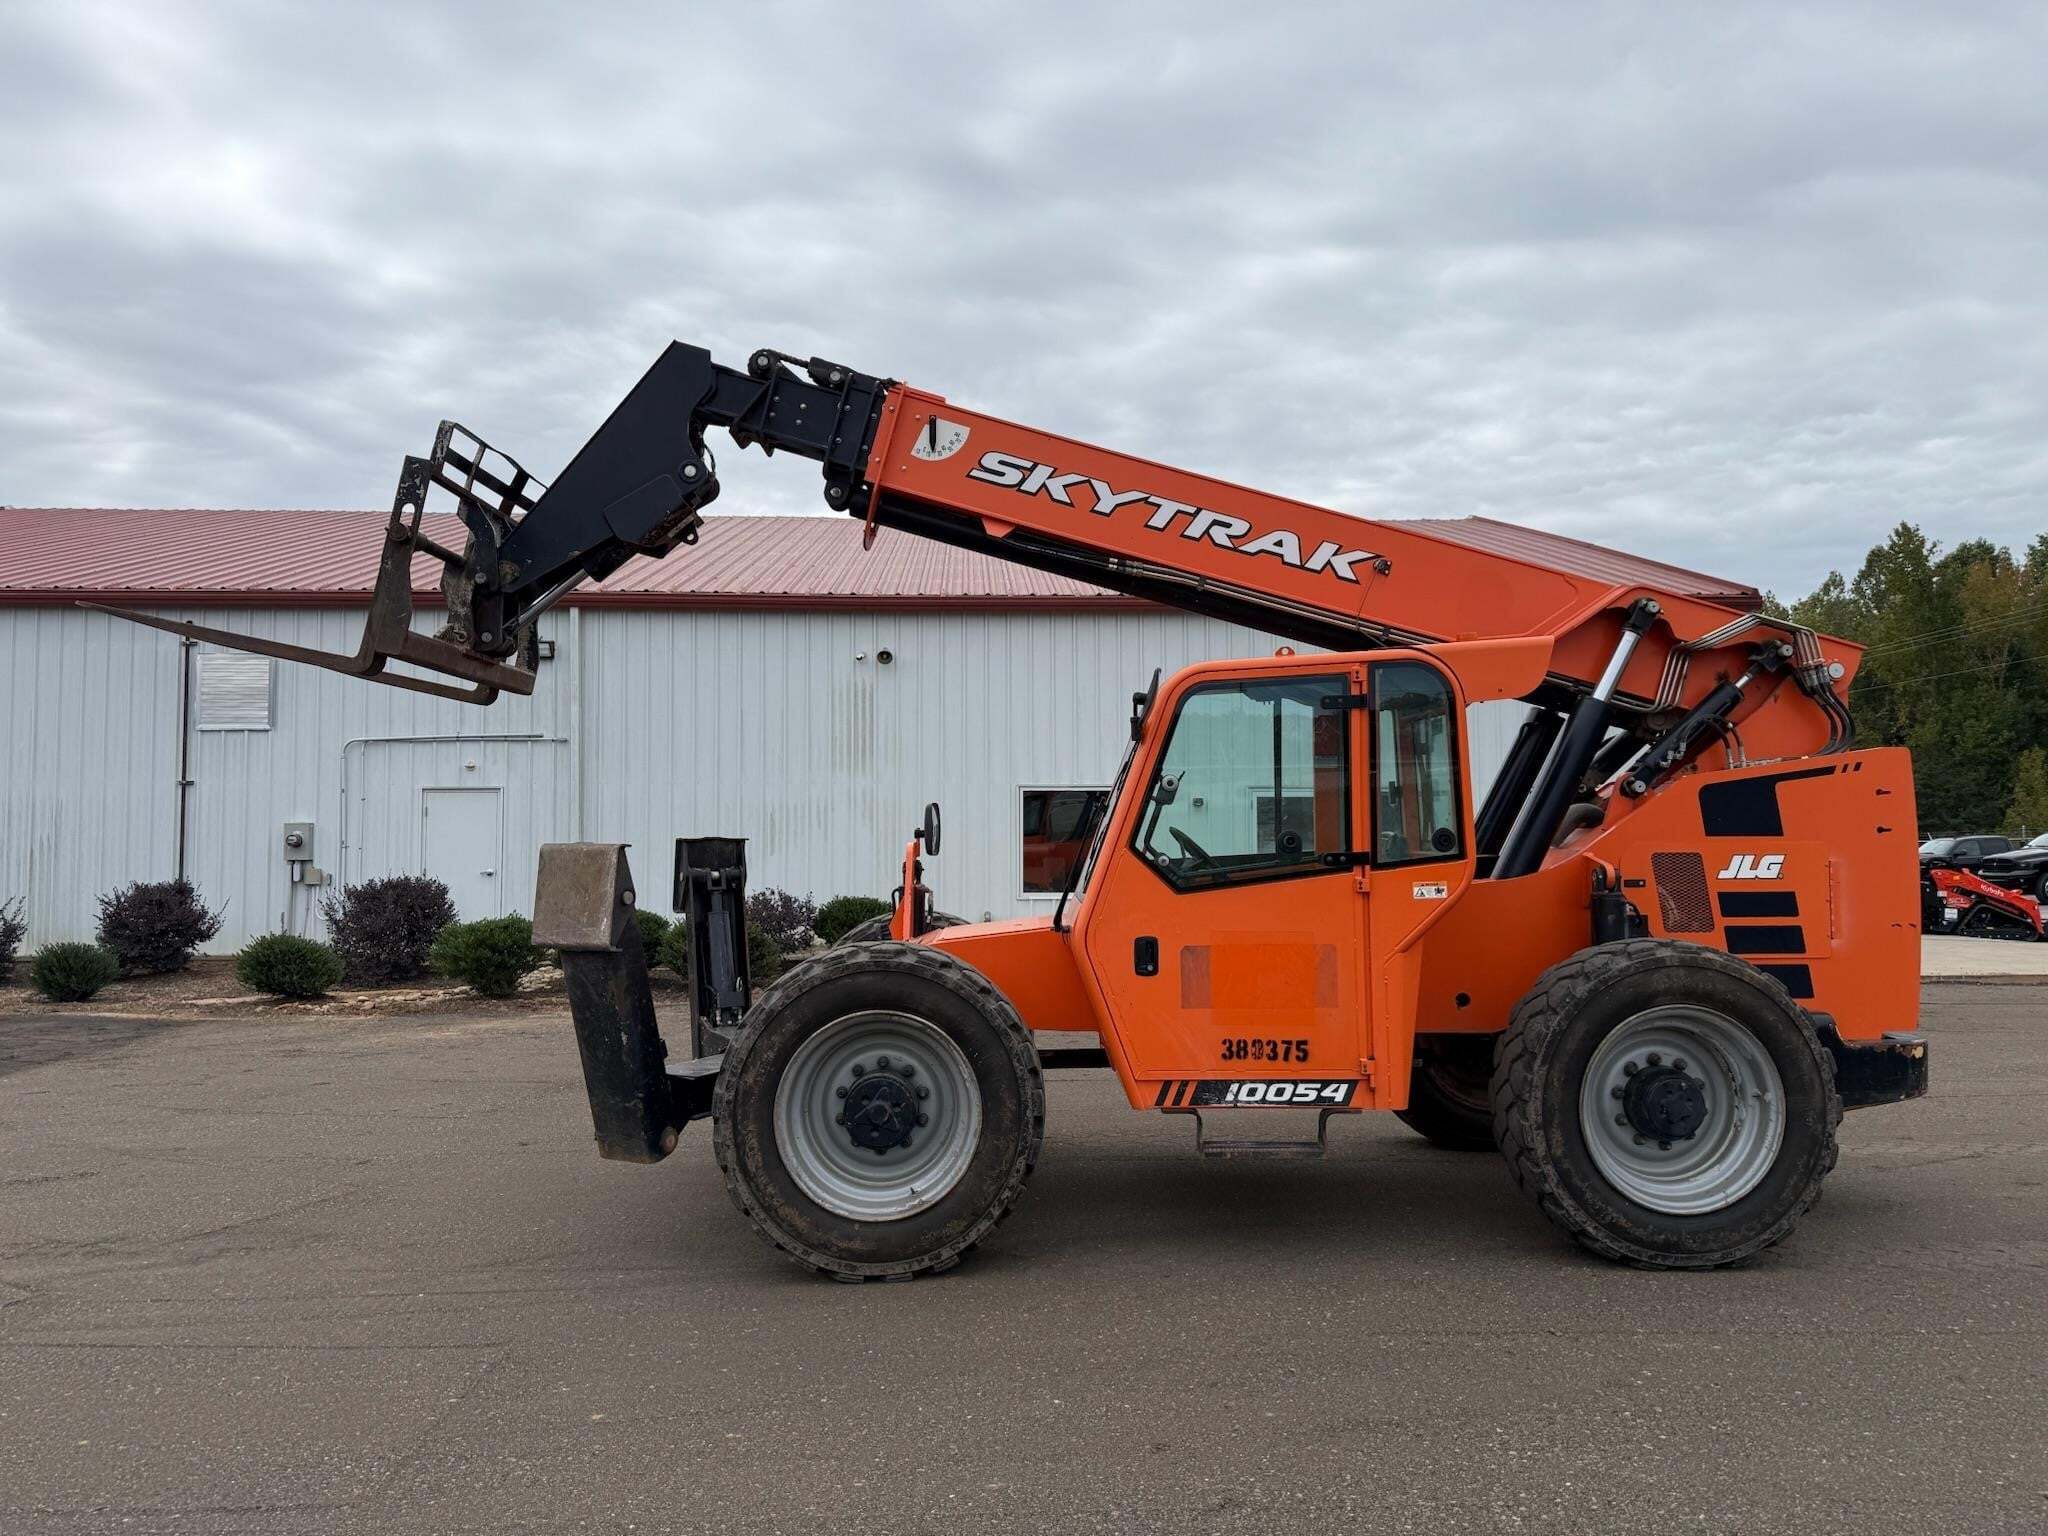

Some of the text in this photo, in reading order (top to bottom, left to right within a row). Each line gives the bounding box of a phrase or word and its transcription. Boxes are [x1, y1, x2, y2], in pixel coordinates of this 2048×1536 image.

[967, 450, 1380, 583] SKYTRAK
[1717, 855, 1784, 879] JLG
[1224, 1082, 1349, 1102] 10054
